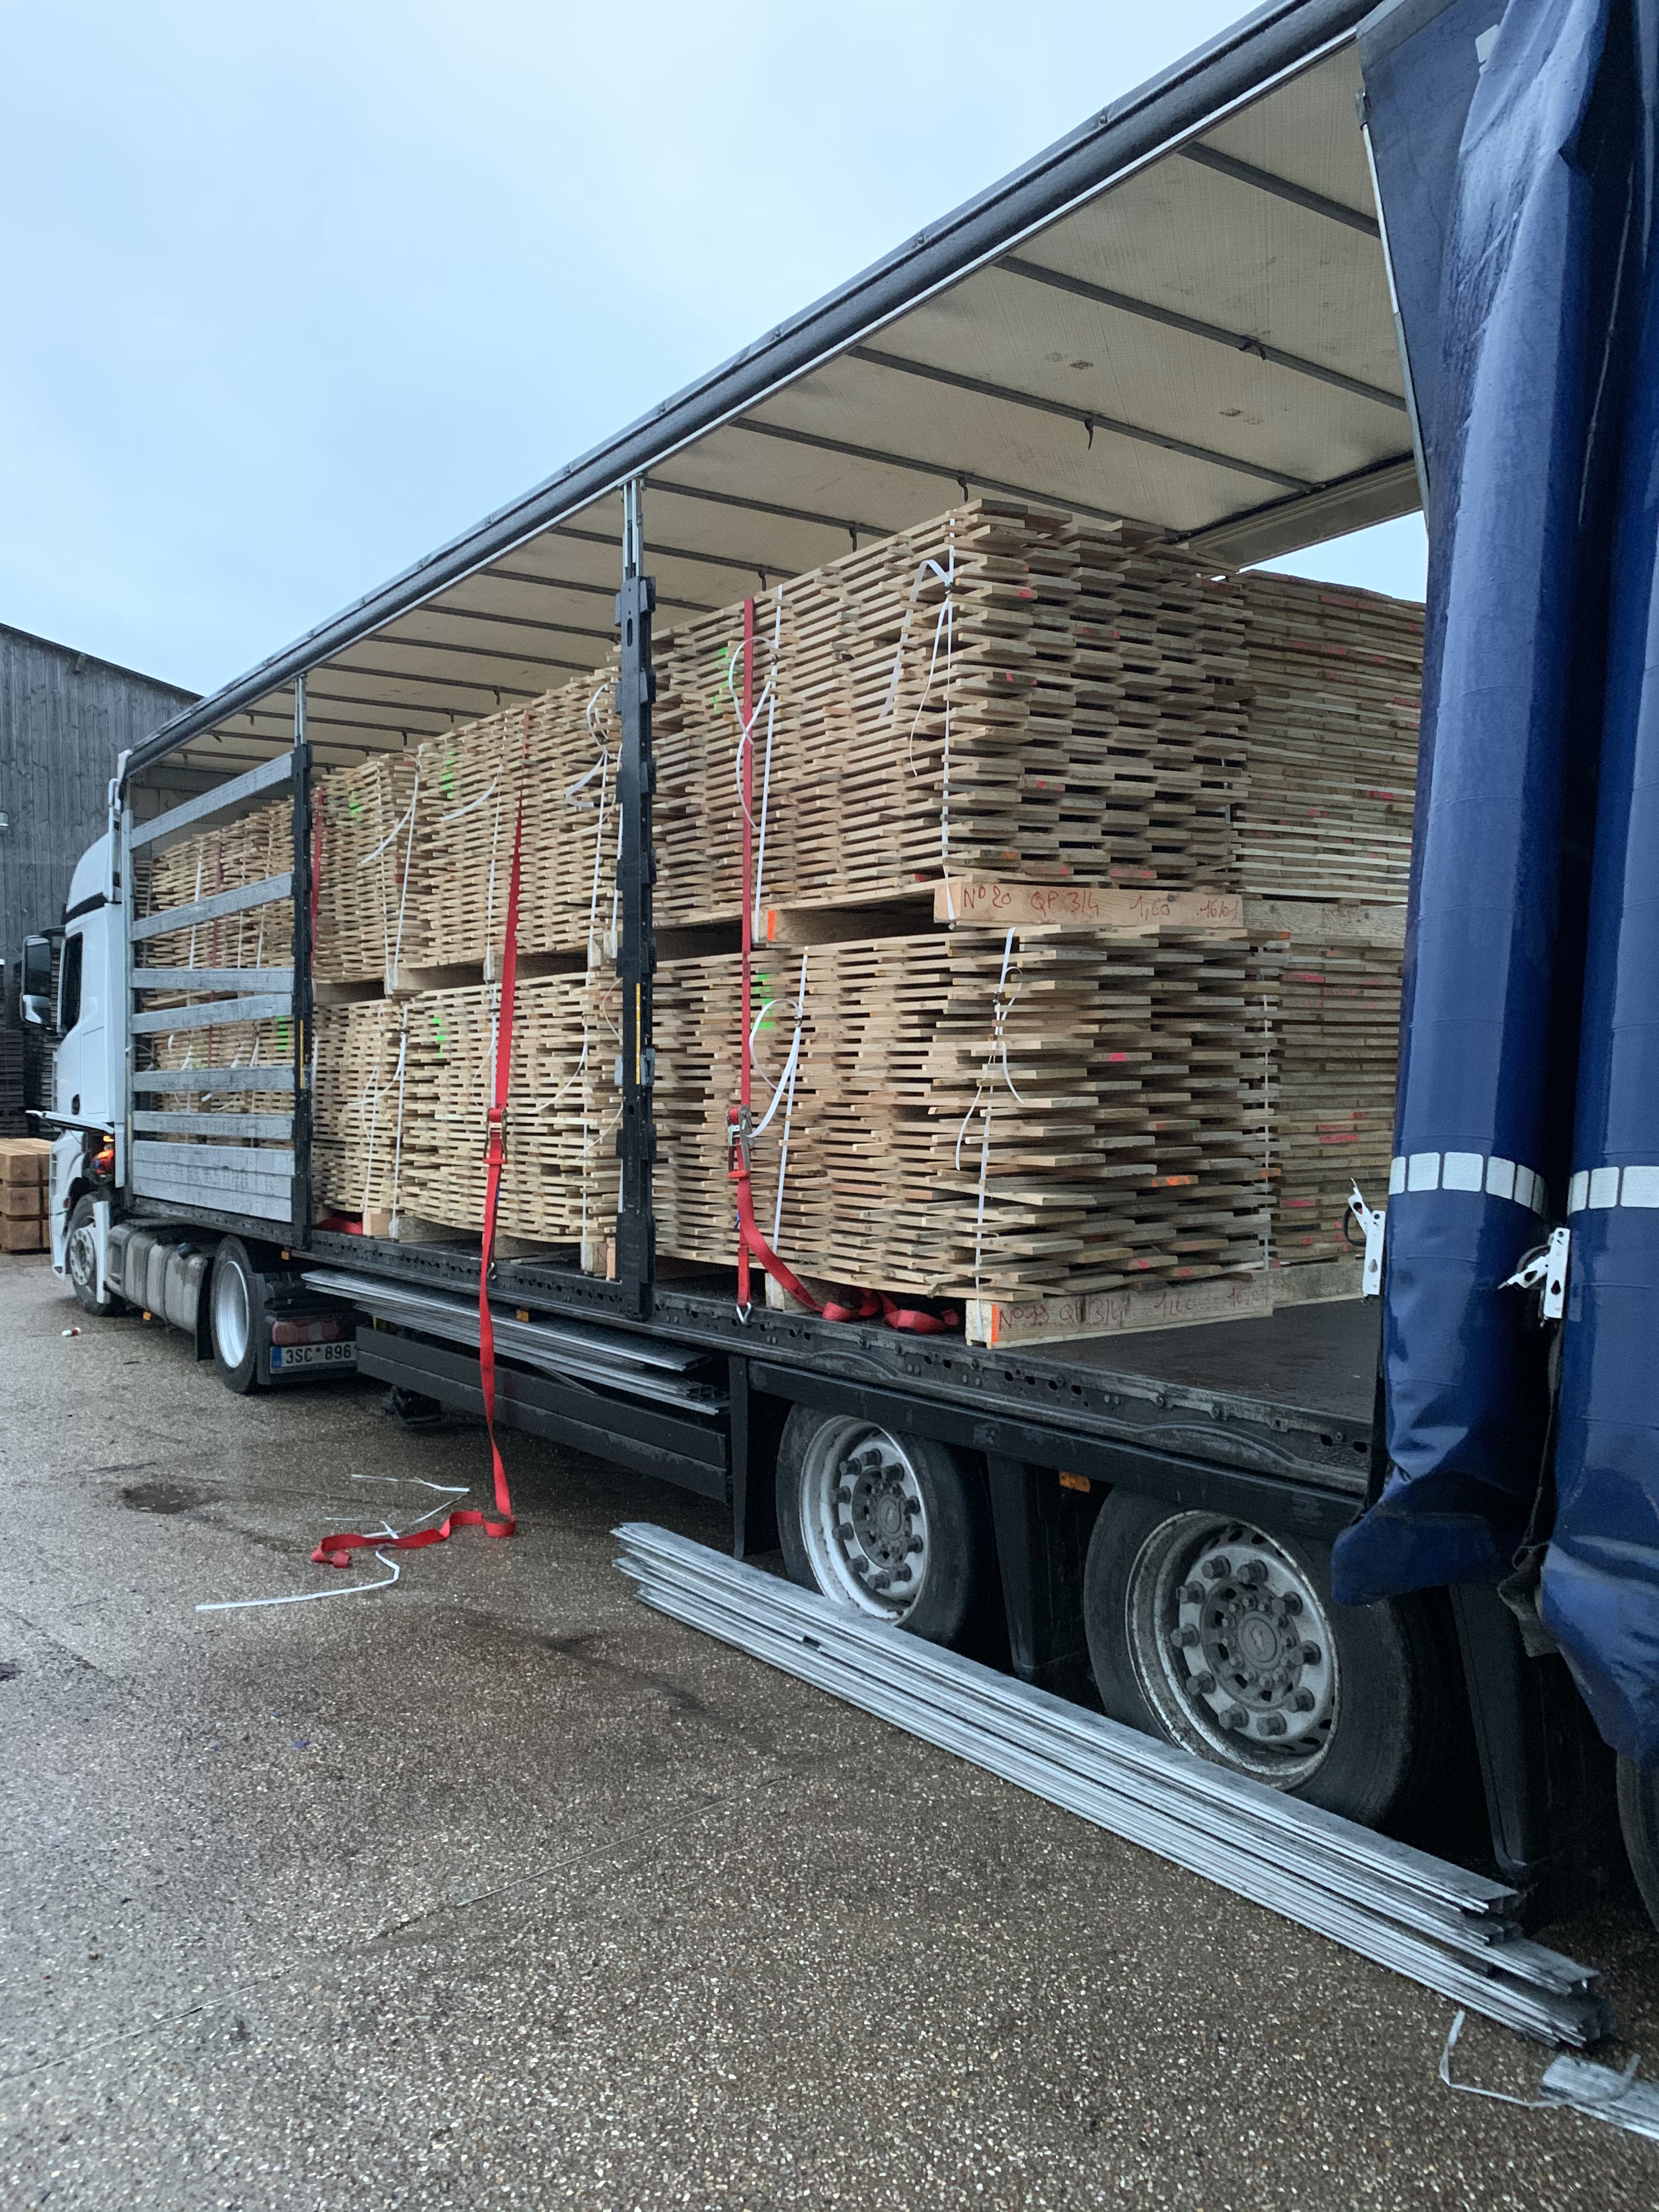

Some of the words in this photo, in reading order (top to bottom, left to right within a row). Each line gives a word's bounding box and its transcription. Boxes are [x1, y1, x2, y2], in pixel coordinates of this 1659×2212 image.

[992, 885, 1012, 909] 20
[285, 1346, 313, 1364] 3SC
[324, 1344, 357, 1361] 896
